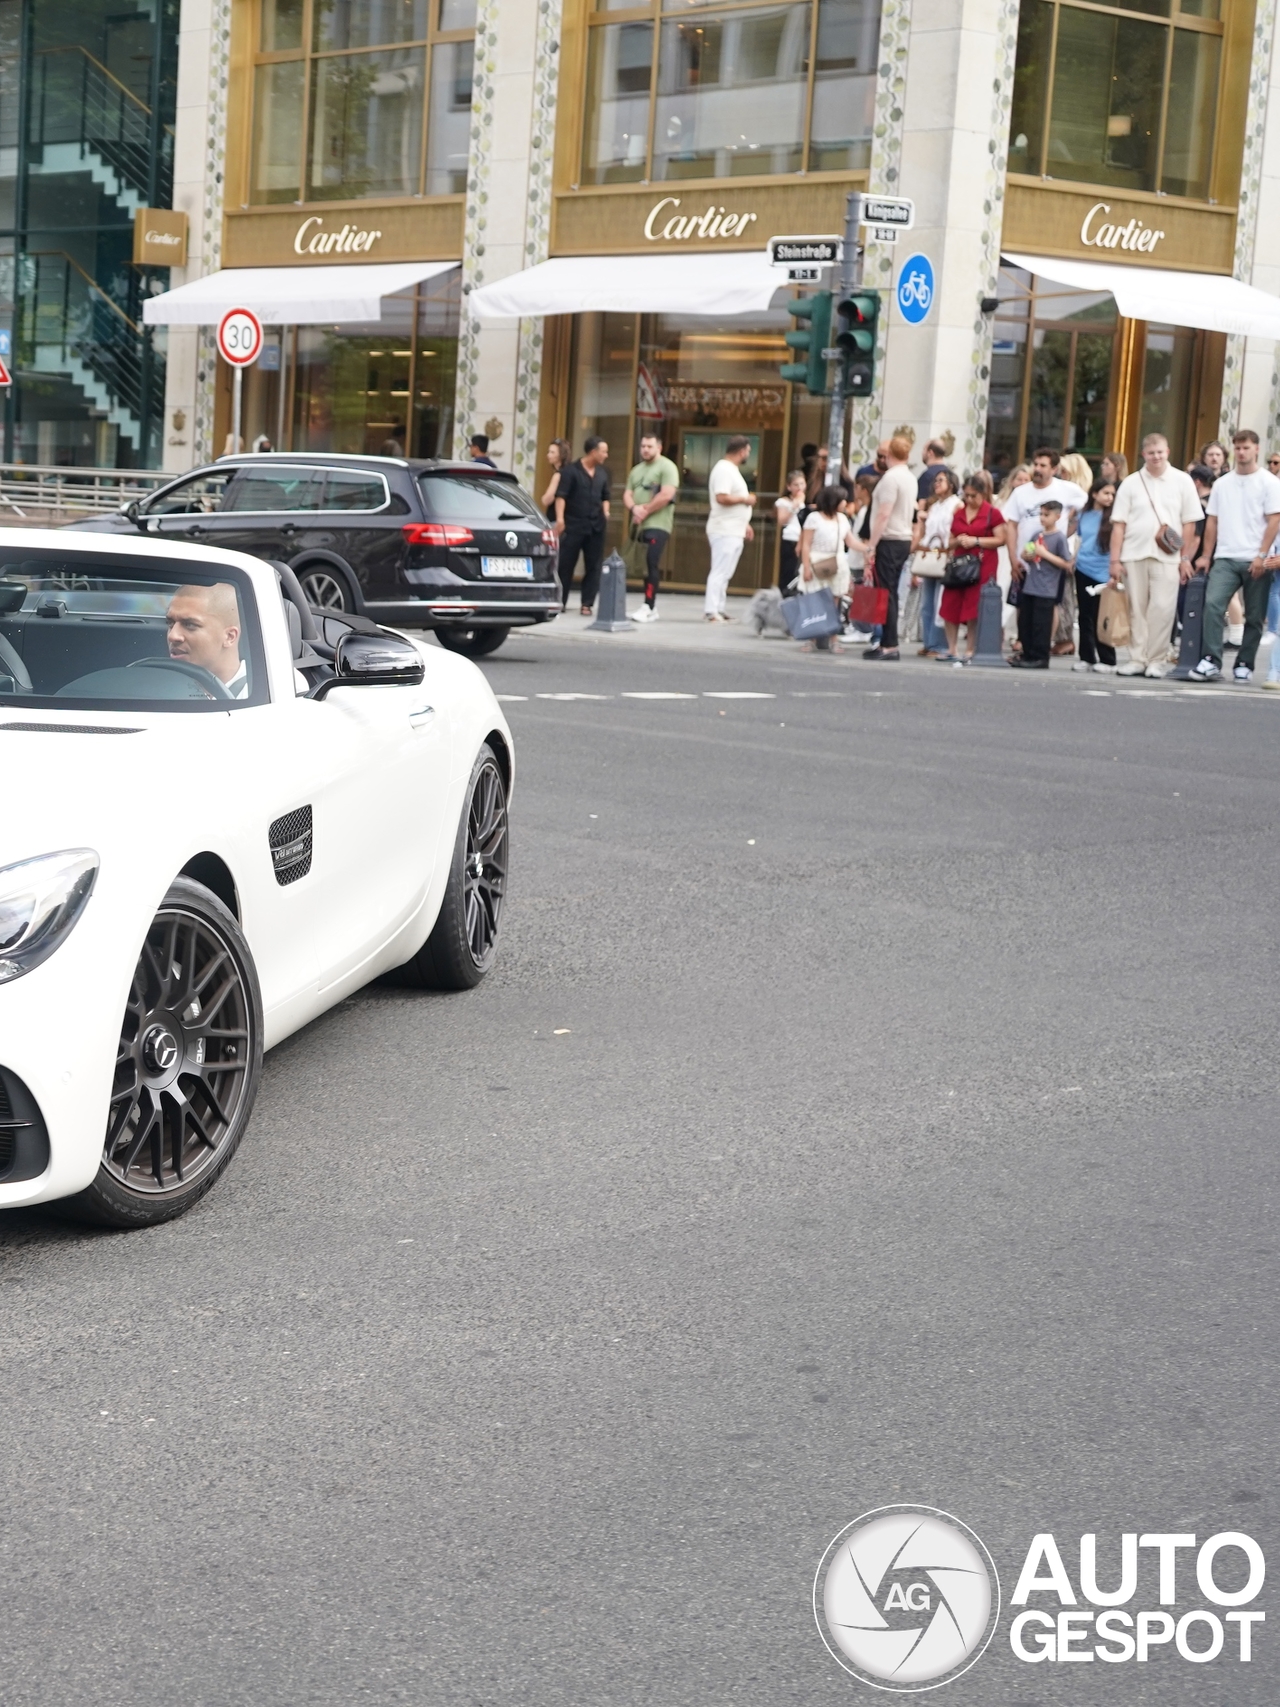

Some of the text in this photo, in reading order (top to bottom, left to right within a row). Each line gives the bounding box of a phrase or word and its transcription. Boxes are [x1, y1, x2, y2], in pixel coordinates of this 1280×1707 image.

[644, 197, 757, 240] Cartier
[1081, 203, 1165, 252] Cartier
[145, 229, 182, 246] Cartier
[294, 216, 382, 254] Cartier
[777, 243, 832, 260] Steinstraße
[228, 324, 253, 350] 30
